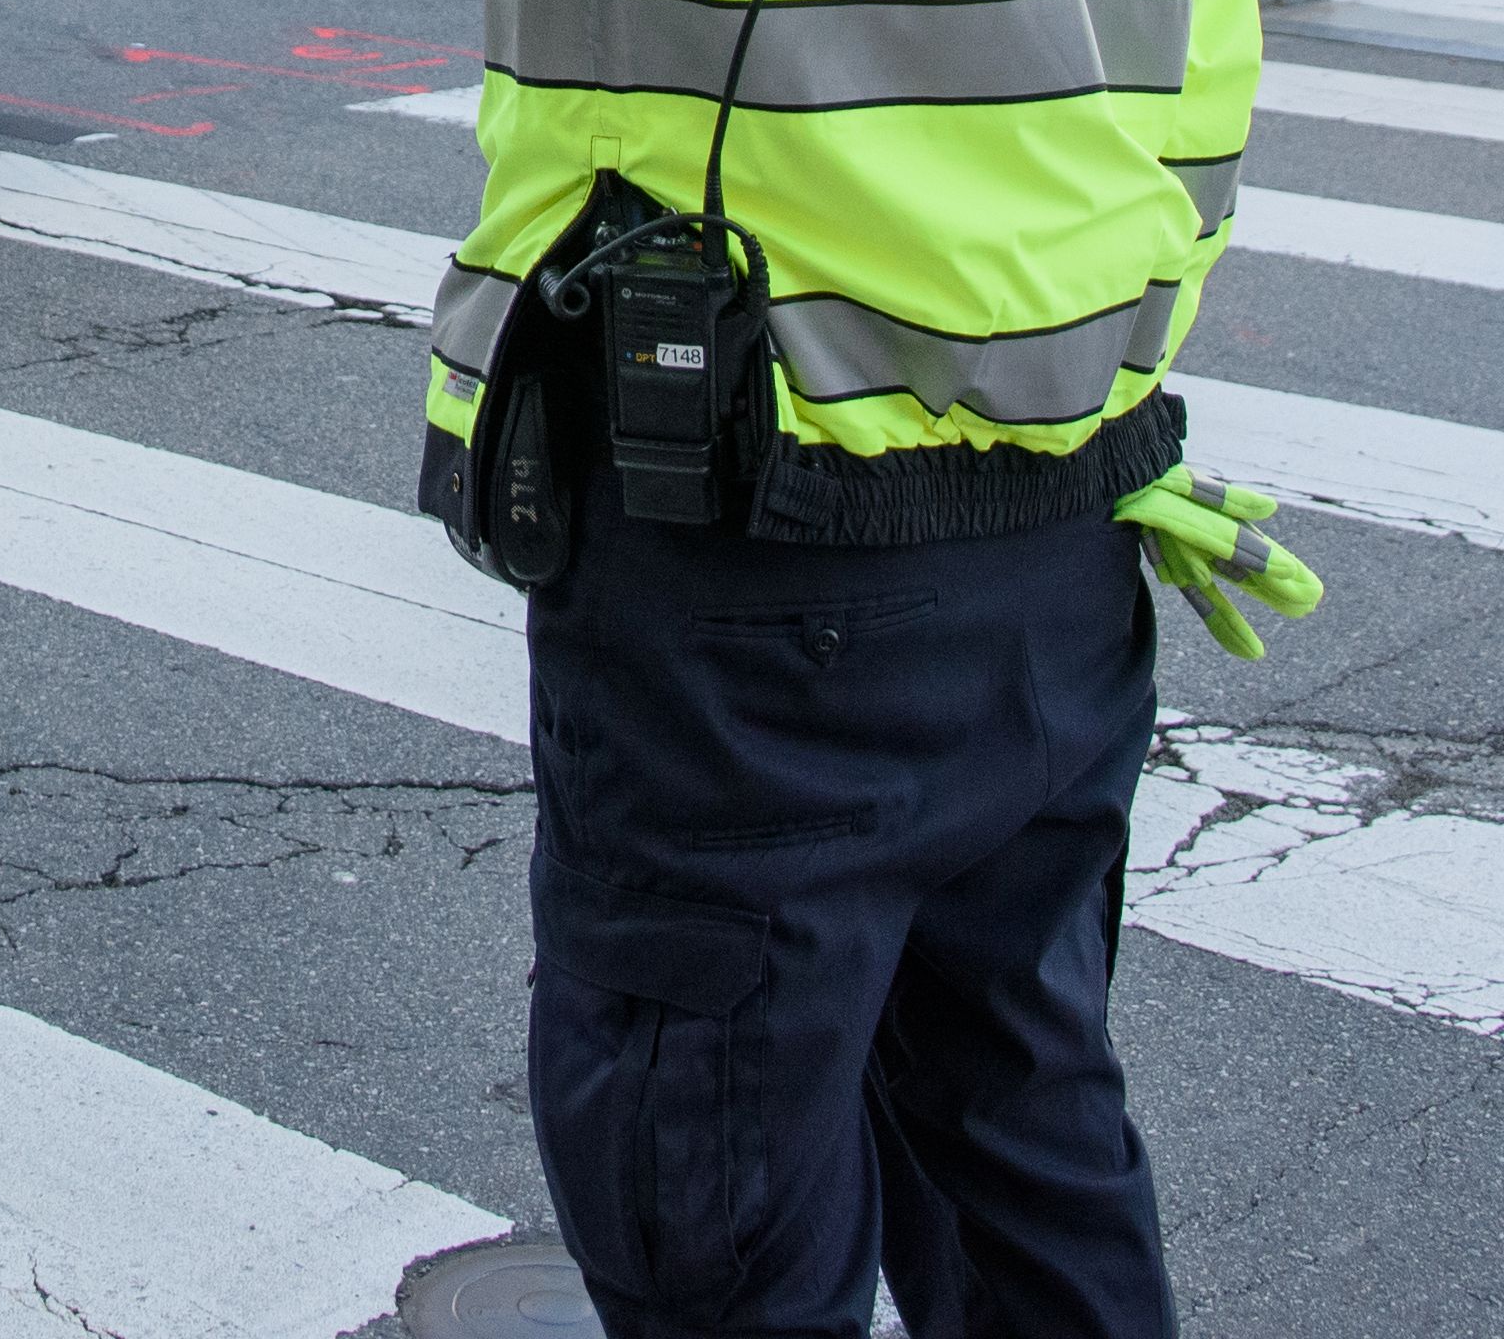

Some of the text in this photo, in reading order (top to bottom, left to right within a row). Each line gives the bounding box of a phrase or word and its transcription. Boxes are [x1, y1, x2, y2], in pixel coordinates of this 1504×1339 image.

[634, 291, 677, 301] MOTOROLA
[635, 352, 657, 363] DPT
[658, 346, 702, 365] 7148
